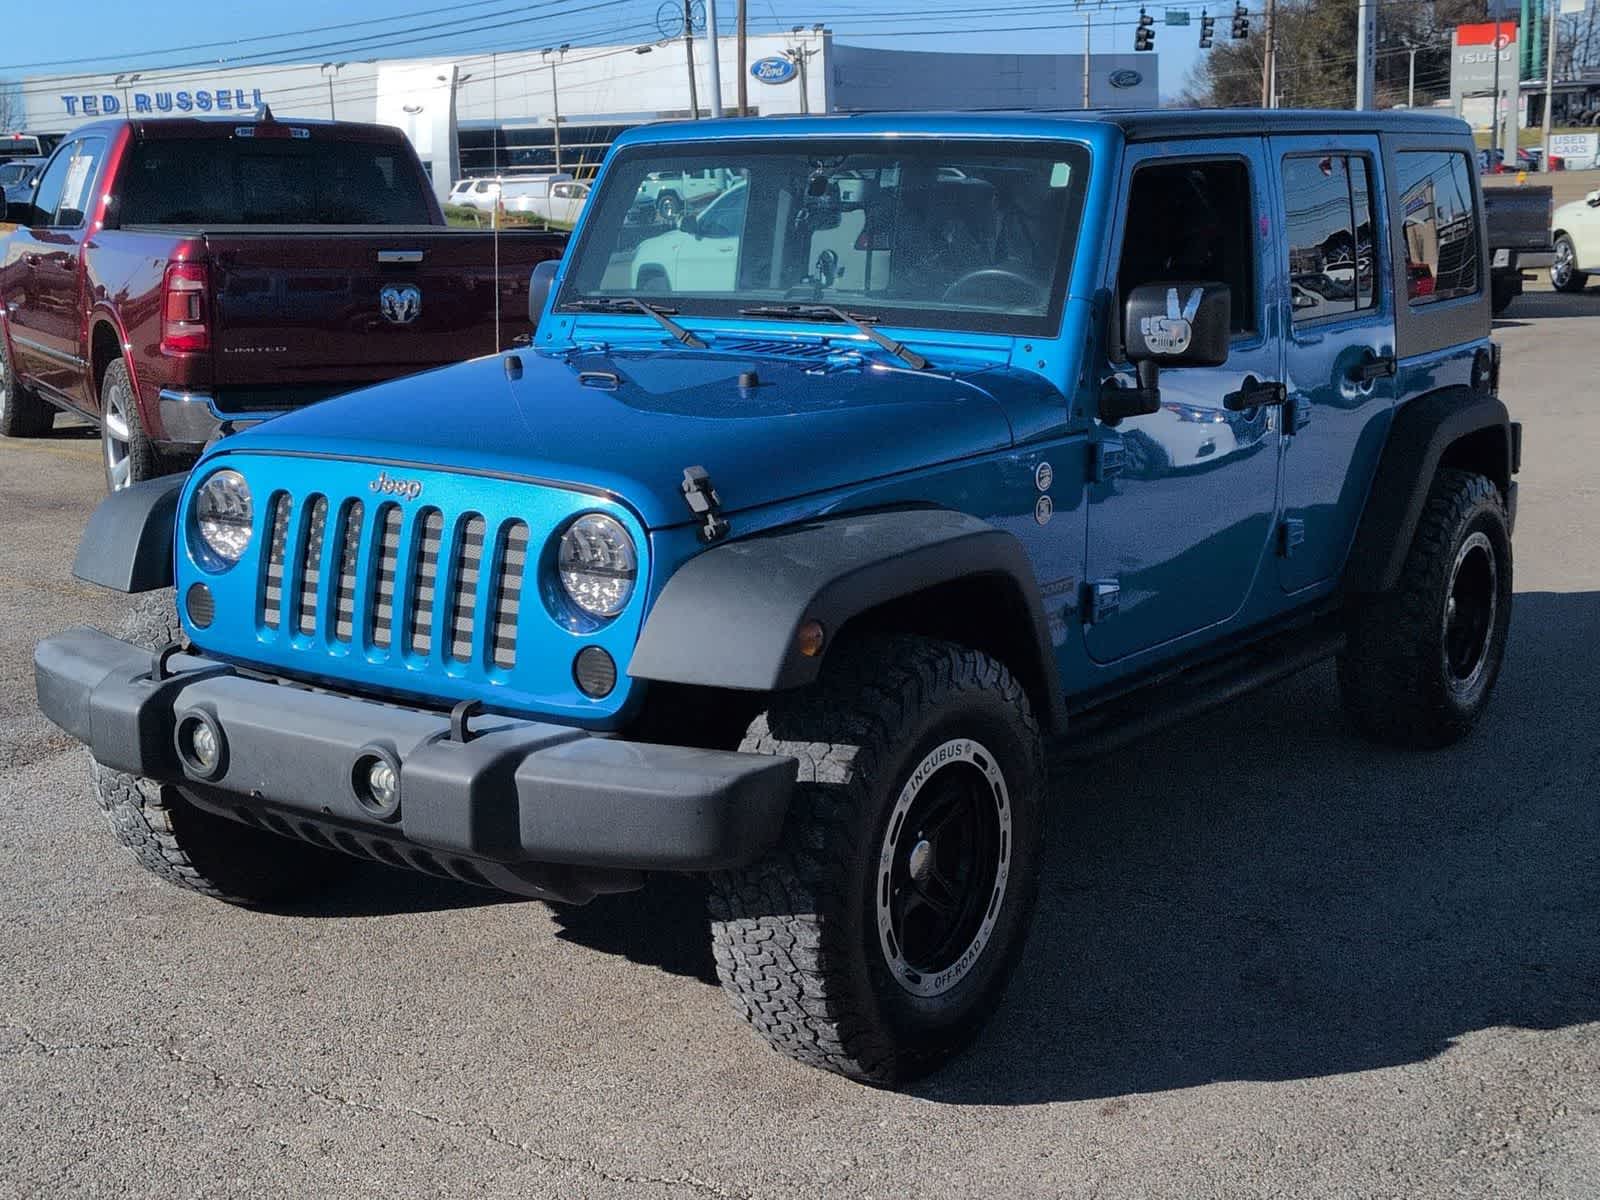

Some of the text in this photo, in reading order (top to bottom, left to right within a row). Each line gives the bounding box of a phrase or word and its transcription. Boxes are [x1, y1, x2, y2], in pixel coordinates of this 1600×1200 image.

[1457, 50, 1512, 64] ISUZU
[758, 61, 785, 78] Ford
[61, 89, 266, 116] TED RUSSELL
[1554, 135, 1585, 145] USED
[1553, 144, 1585, 154] CARS
[369, 471, 421, 501] Jeep
[910, 744, 962, 790] INCUBUS
